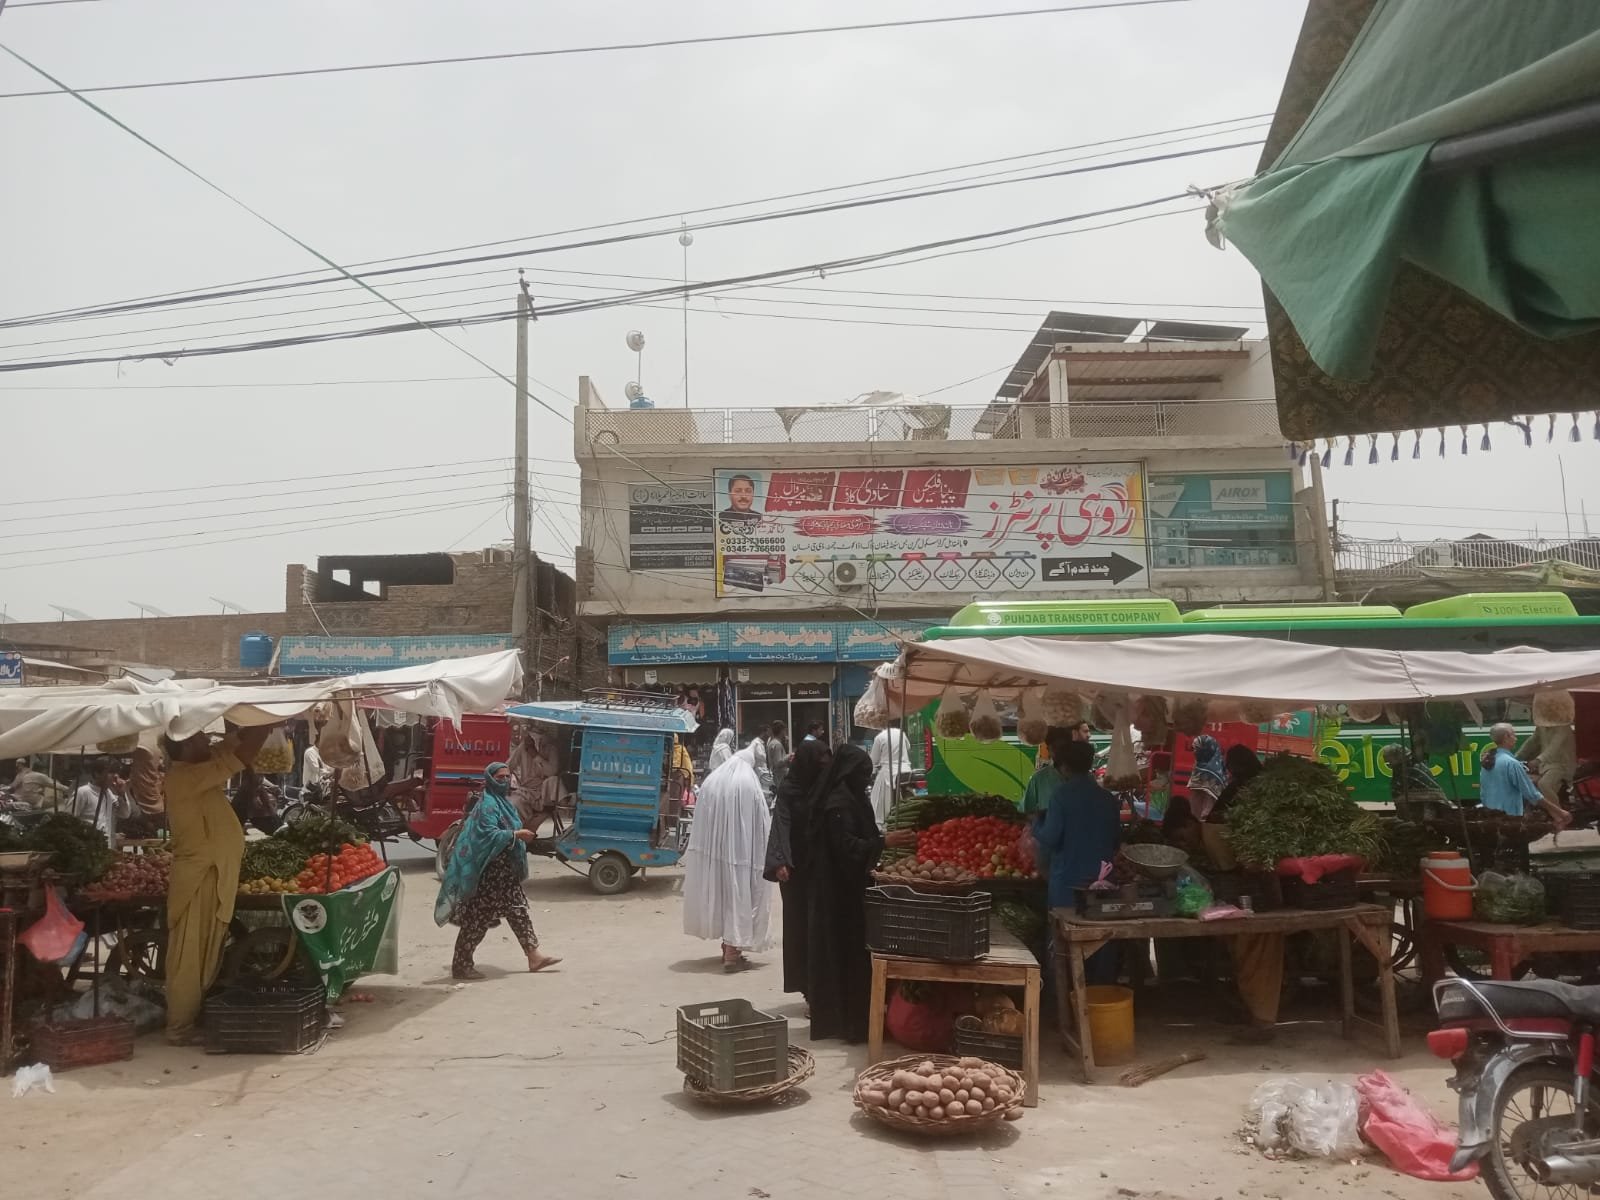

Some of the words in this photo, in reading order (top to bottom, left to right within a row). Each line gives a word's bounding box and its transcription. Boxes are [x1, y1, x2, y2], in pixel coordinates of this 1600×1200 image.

[1216, 487, 1262, 500] AIROX
[981, 489, 1056, 551] پرنٹرز
[1049, 560, 1072, 577] آگے
[1071, 563, 1090, 577] قدم
[1091, 563, 1110, 576] چند
[1522, 605, 1563, 615] Electric
[1004, 614, 1046, 624] PUNJAB
[1048, 613, 1111, 623] TRANSPORT
[1112, 612, 1162, 623] COMPANY
